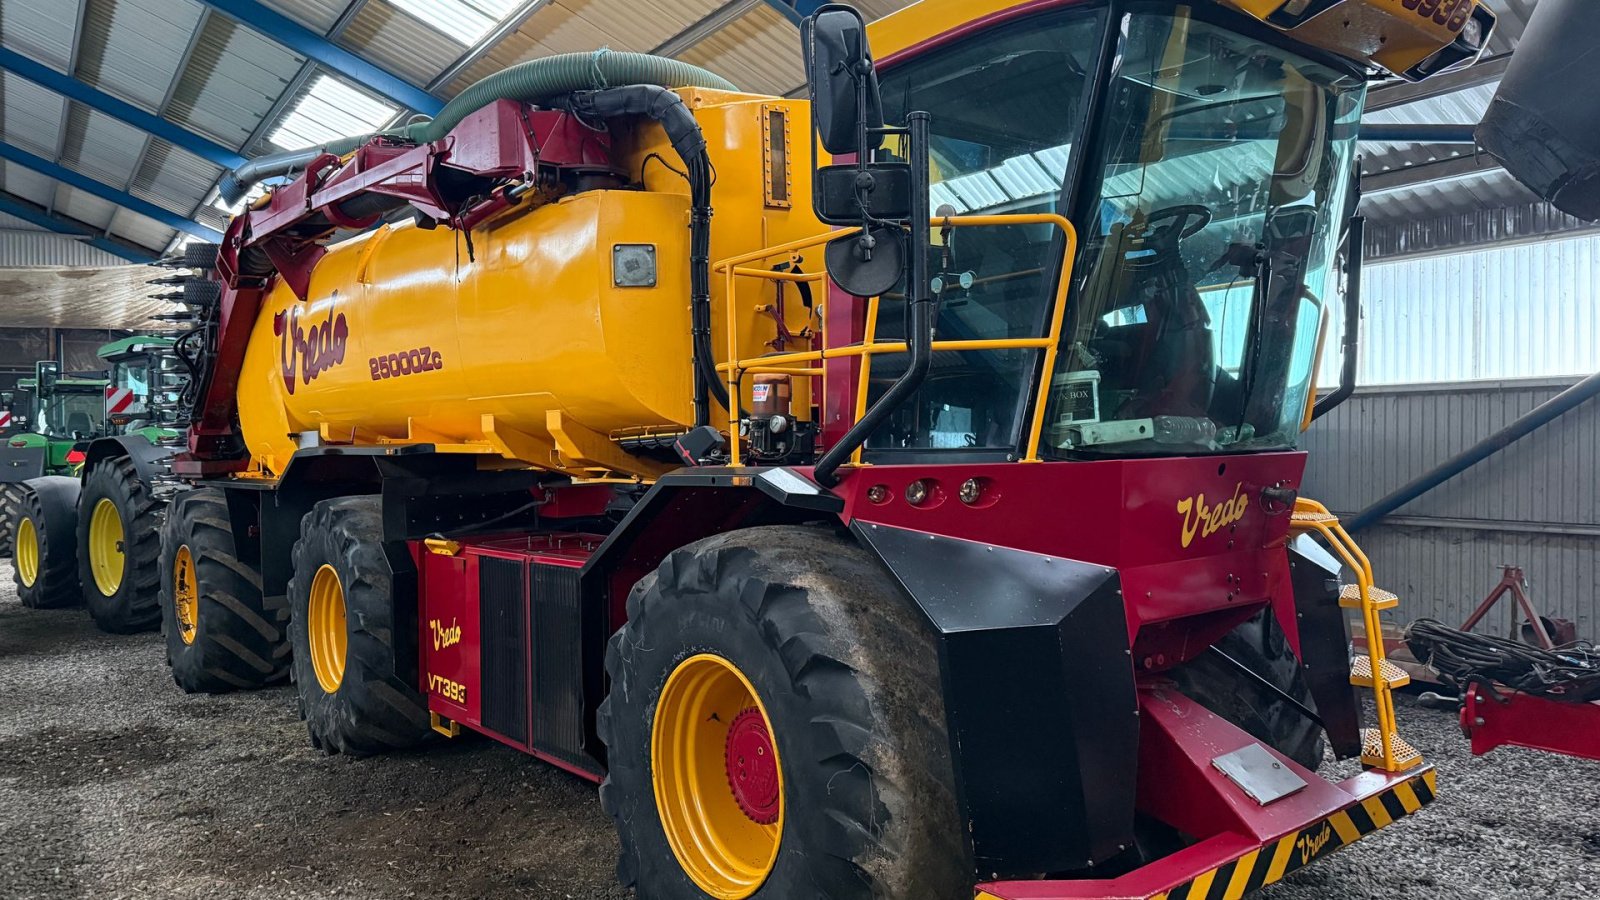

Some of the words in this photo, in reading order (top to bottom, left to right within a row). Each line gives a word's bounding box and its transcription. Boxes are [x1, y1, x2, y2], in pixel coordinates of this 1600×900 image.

[274, 289, 348, 395] Vredo
[369, 347, 442, 381] 25000Zc
[1070, 390, 1089, 399] BOX
[1177, 481, 1248, 548] Vredo
[430, 617, 461, 651] Vredo
[1297, 821, 1331, 865] Vredo
